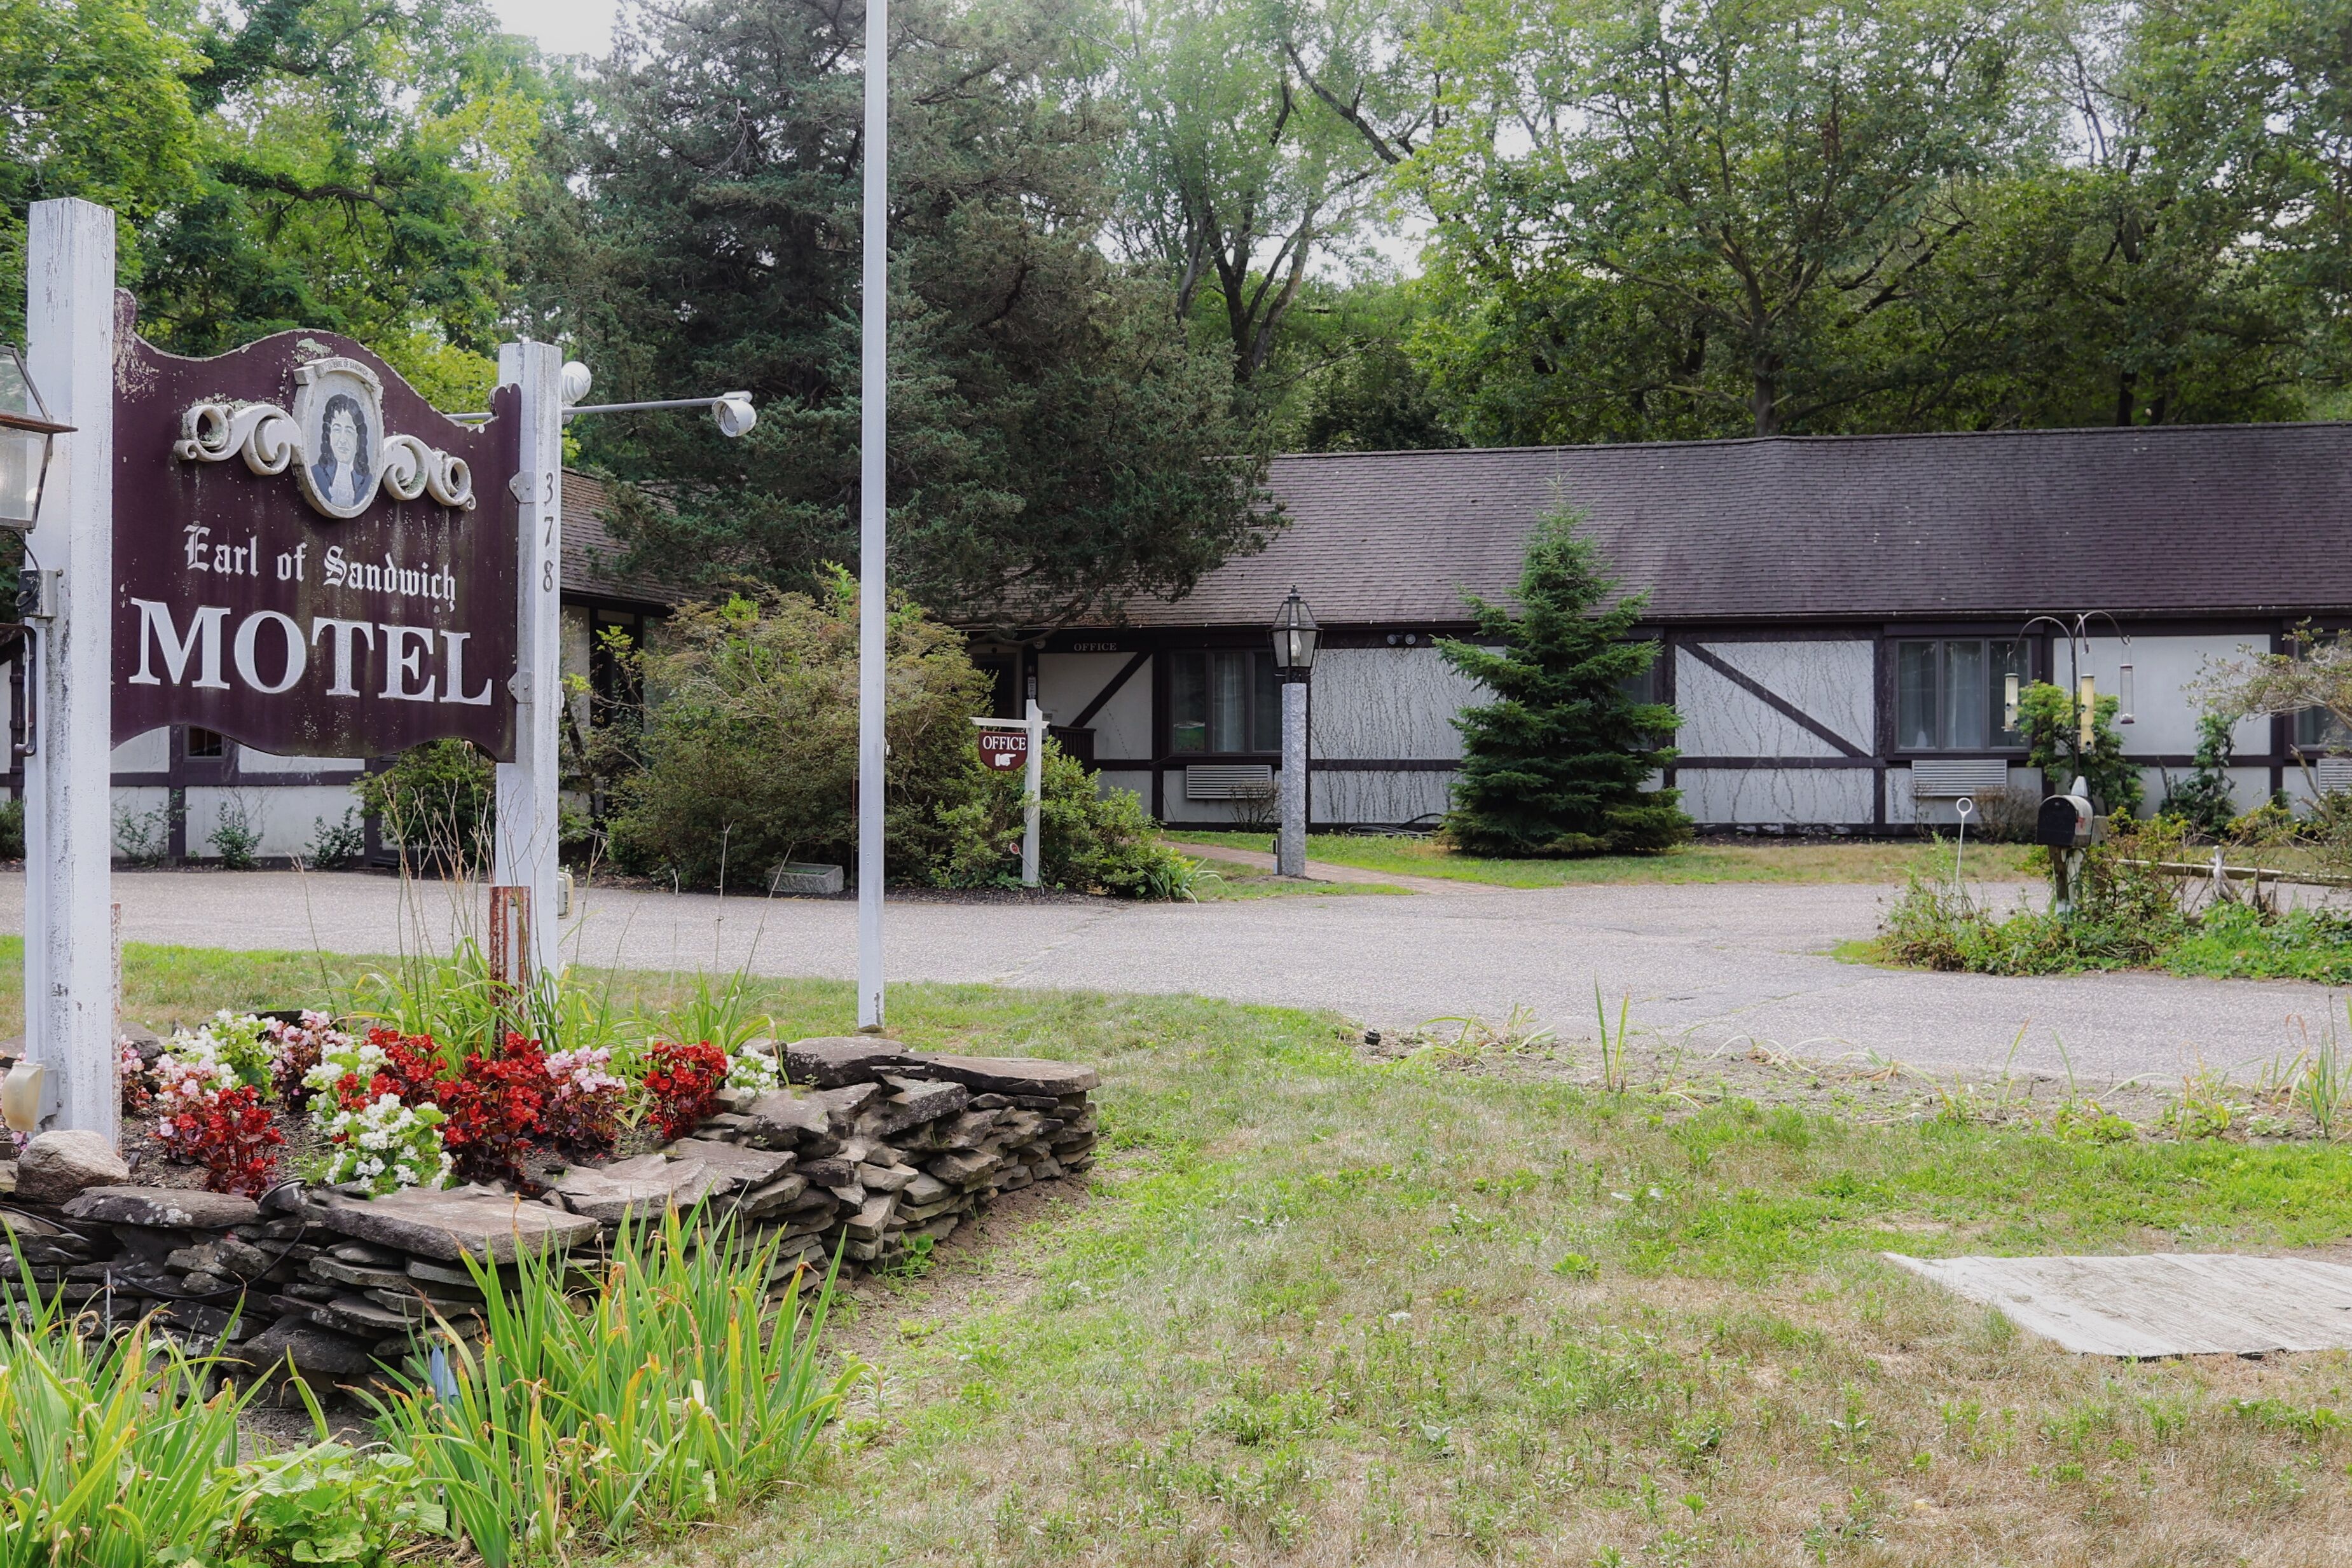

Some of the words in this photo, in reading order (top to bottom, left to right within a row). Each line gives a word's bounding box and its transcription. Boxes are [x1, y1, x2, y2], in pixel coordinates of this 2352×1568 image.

[183, 523, 259, 577] Earl
[277, 542, 308, 582] of
[323, 545, 457, 612] Sandwich
[543, 472, 554, 593] 378
[128, 596, 493, 706] MOTEL
[1073, 642, 1117, 652] OFFICE
[982, 735, 1027, 750] OFFICE
